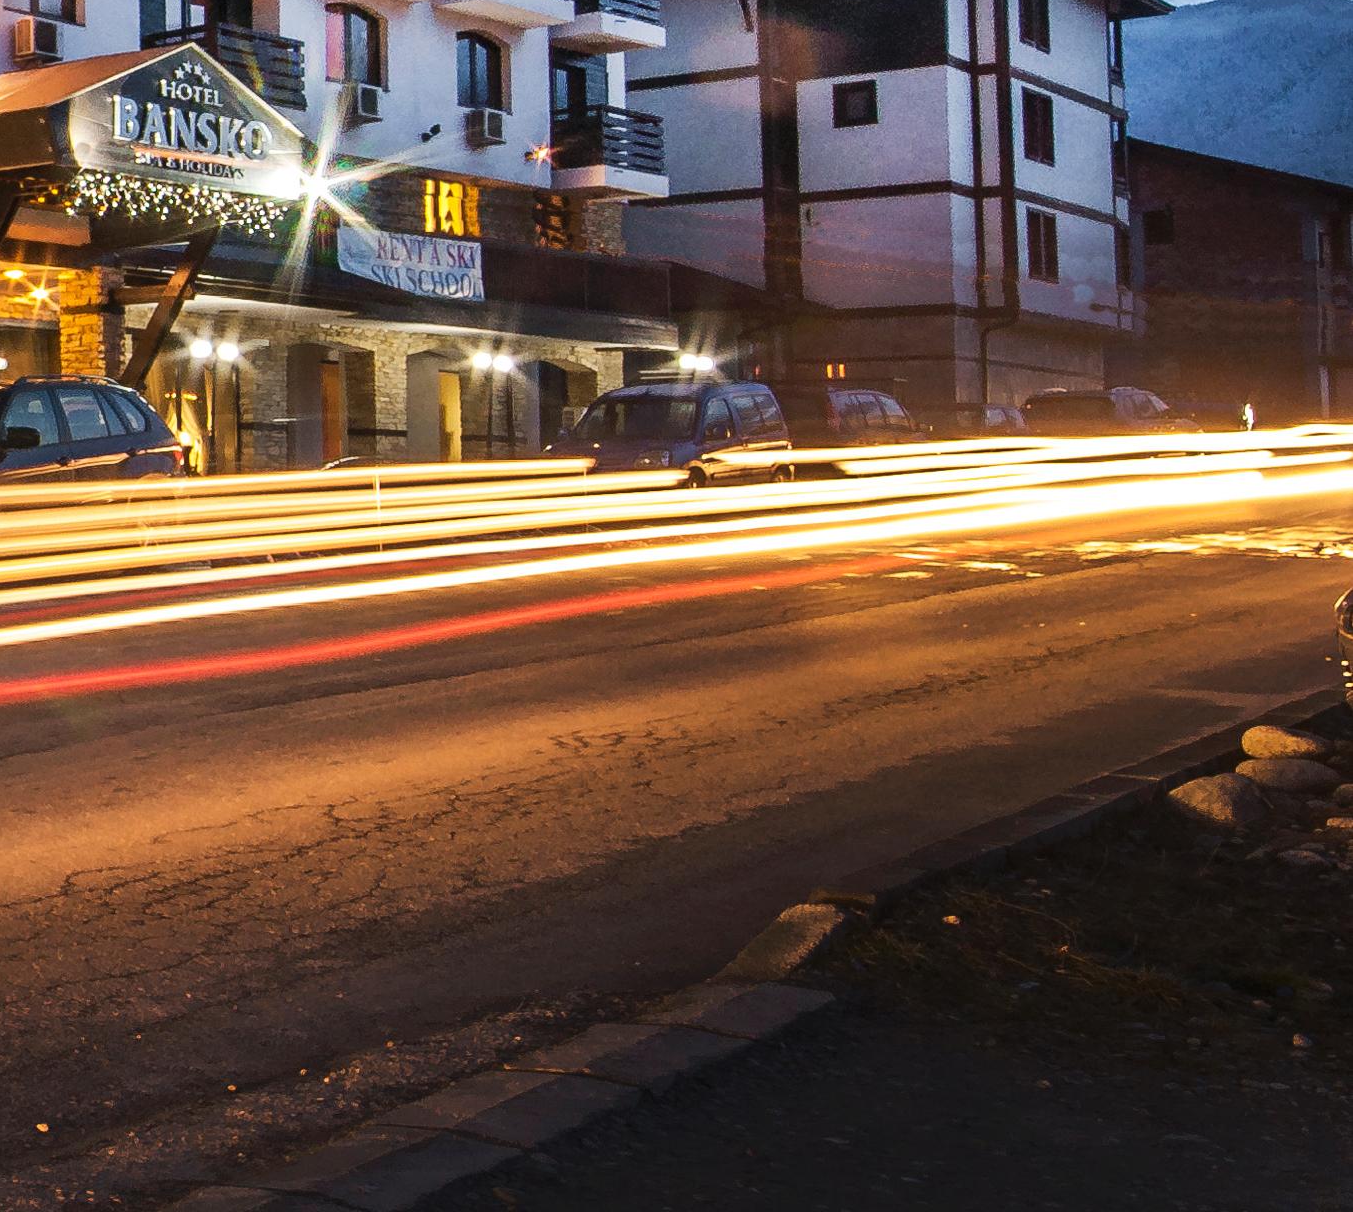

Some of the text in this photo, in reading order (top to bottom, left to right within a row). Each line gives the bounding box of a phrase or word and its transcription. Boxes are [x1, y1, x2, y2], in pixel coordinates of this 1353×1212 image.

[160, 78, 224, 107] HOTEL
[113, 94, 273, 161] BANSKO
[179, 158, 246, 181] HOLIDAYS
[376, 232, 477, 269] RENT A SKI
[371, 264, 484, 302] SKI SCHOOL
